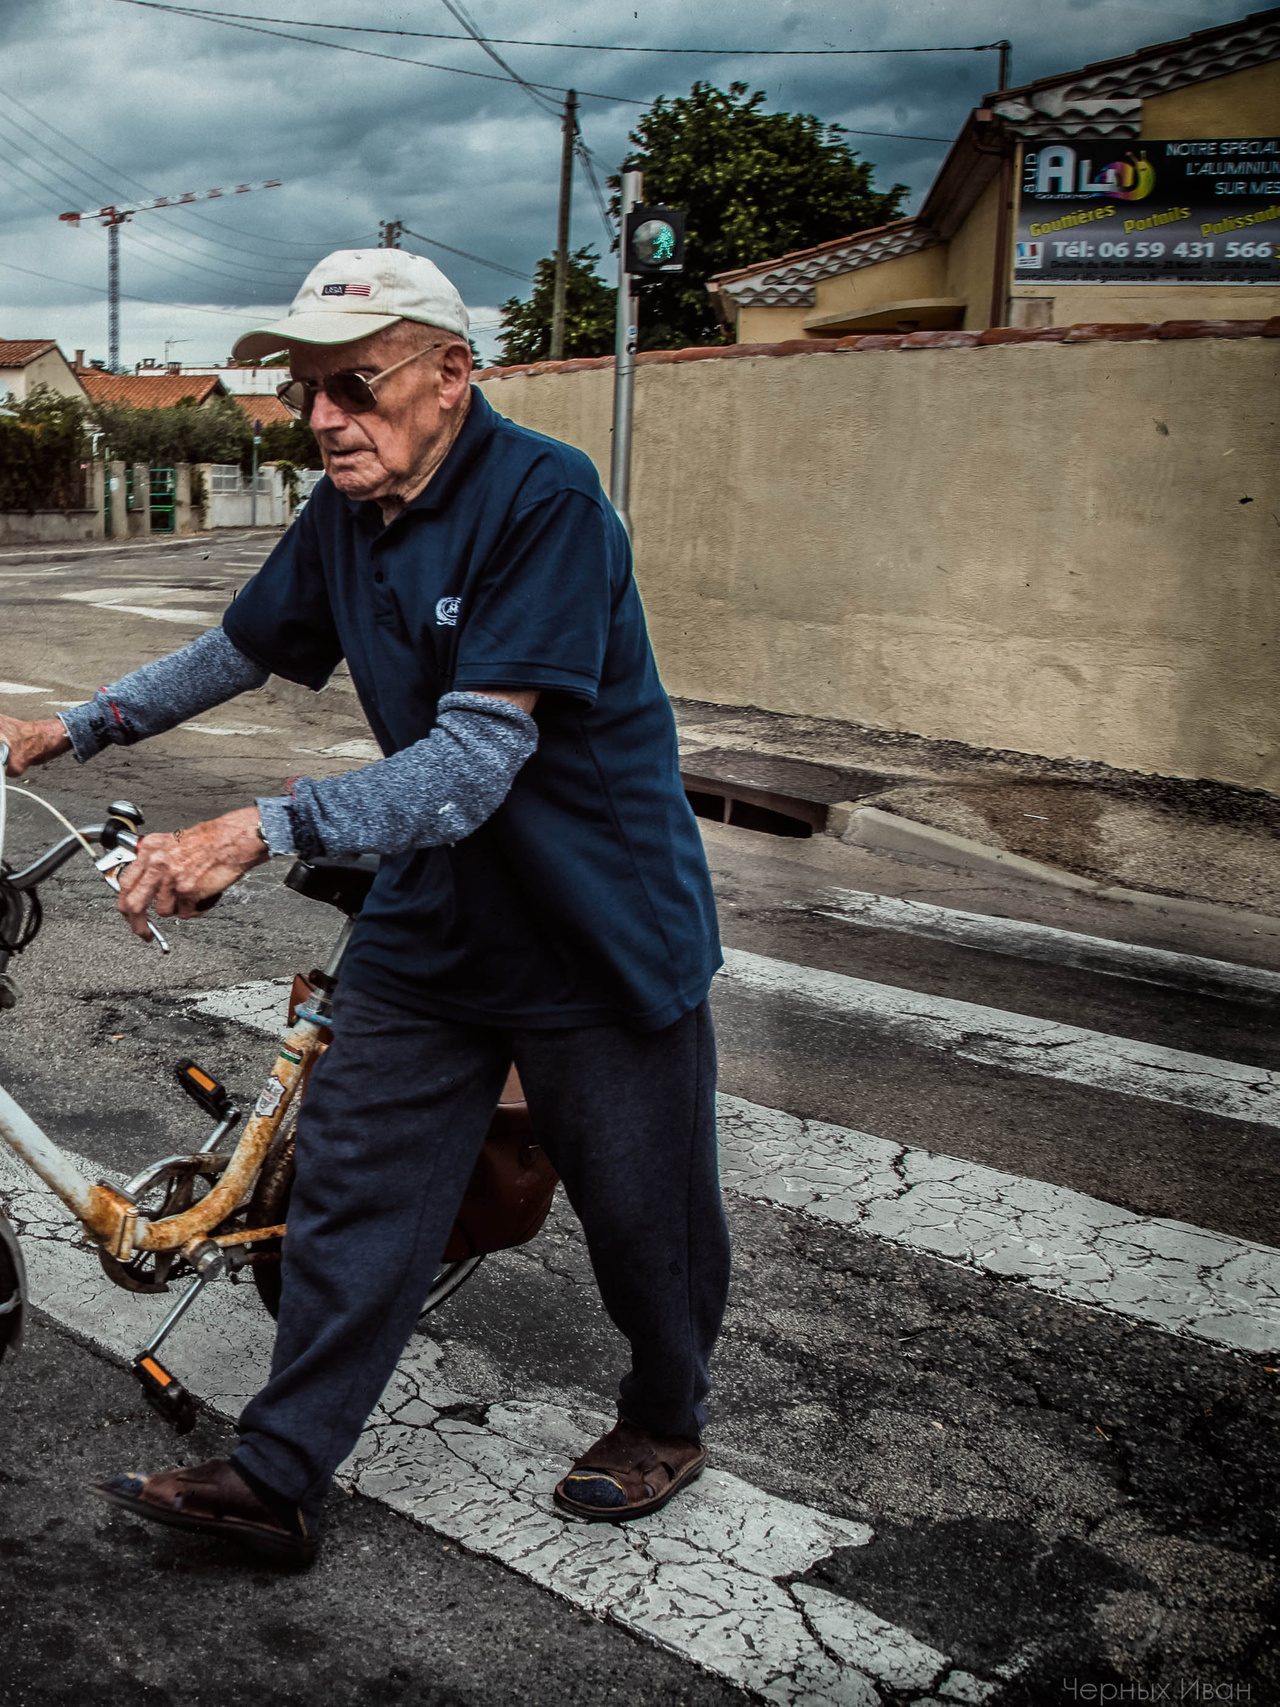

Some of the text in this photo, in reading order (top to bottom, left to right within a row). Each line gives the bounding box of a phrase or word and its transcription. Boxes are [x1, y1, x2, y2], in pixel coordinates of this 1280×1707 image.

[1165, 142, 1218, 156] NOTRE
[1214, 181, 1248, 195] SUR
[1029, 204, 1117, 237] Gouttières
[1123, 205, 1192, 234] Portails
[1098, 241, 1129, 258] 06
[1134, 241, 1166, 258] 59
[1172, 241, 1215, 258] 431
[1224, 241, 1272, 258] 566
[324, 286, 343, 294] USA
